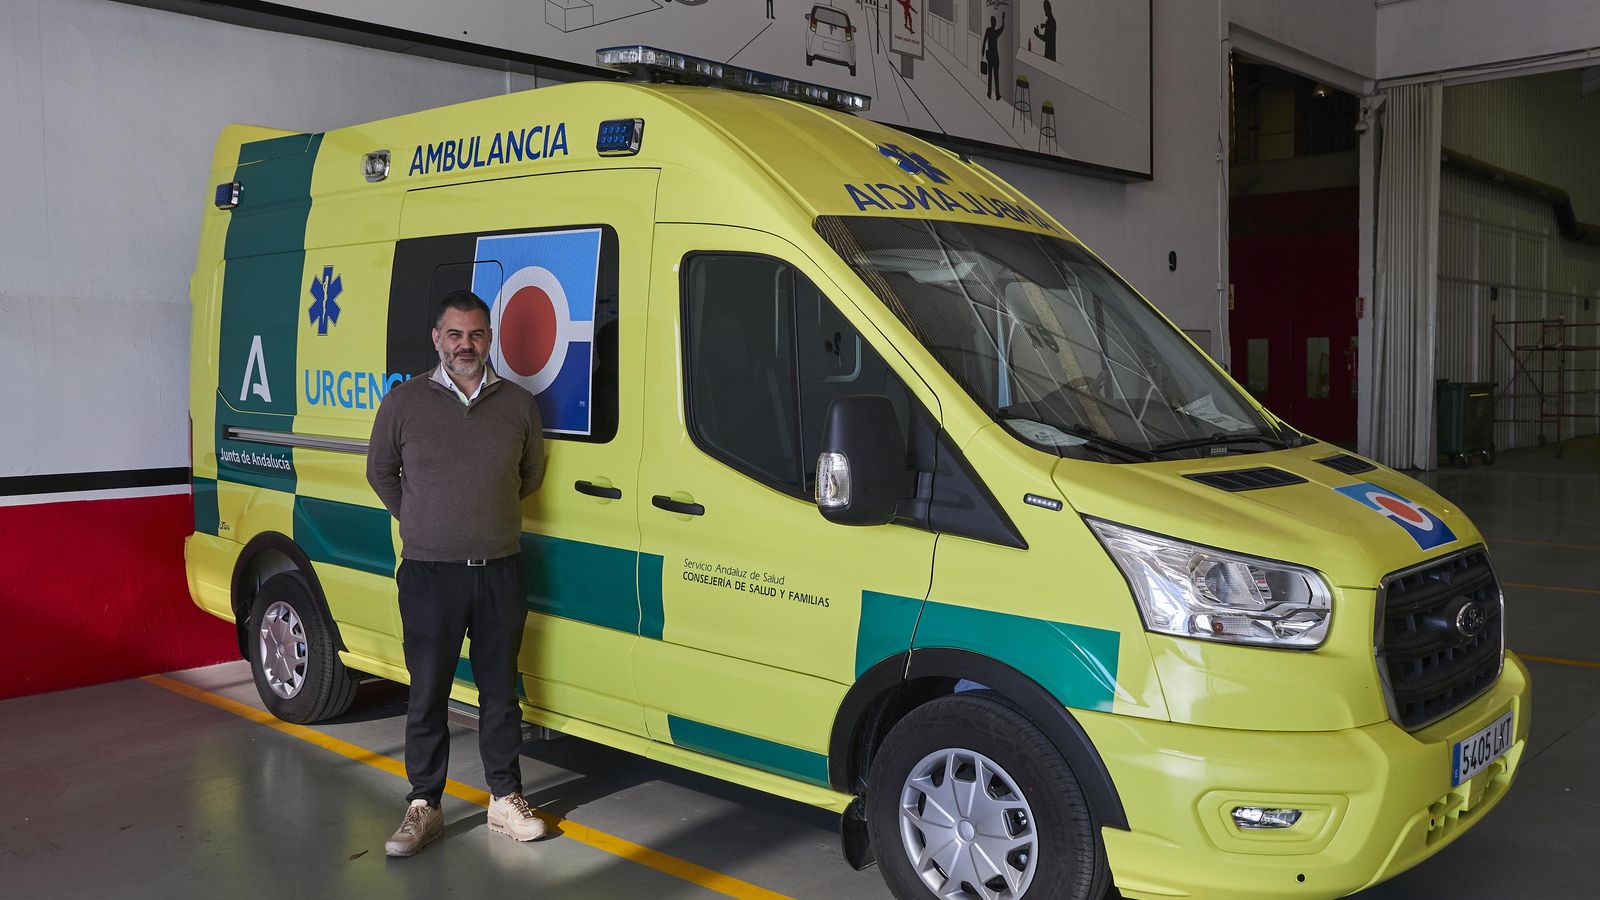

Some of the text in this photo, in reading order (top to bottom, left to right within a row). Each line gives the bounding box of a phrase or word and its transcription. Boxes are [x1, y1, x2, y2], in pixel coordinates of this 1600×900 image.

[408, 122, 569, 176] AMBULANCIA
[1168, 250, 1177, 271] 9
[305, 369, 411, 410] URGEN
[220, 447, 291, 471] Junta de Andalucía
[682, 571, 830, 608] CONSEJERÍA DE SALUD Y FAMILIAS
[683, 558, 785, 585] Servicio Andaluz de Salud
[1462, 716, 1511, 775] 5405 LKT
